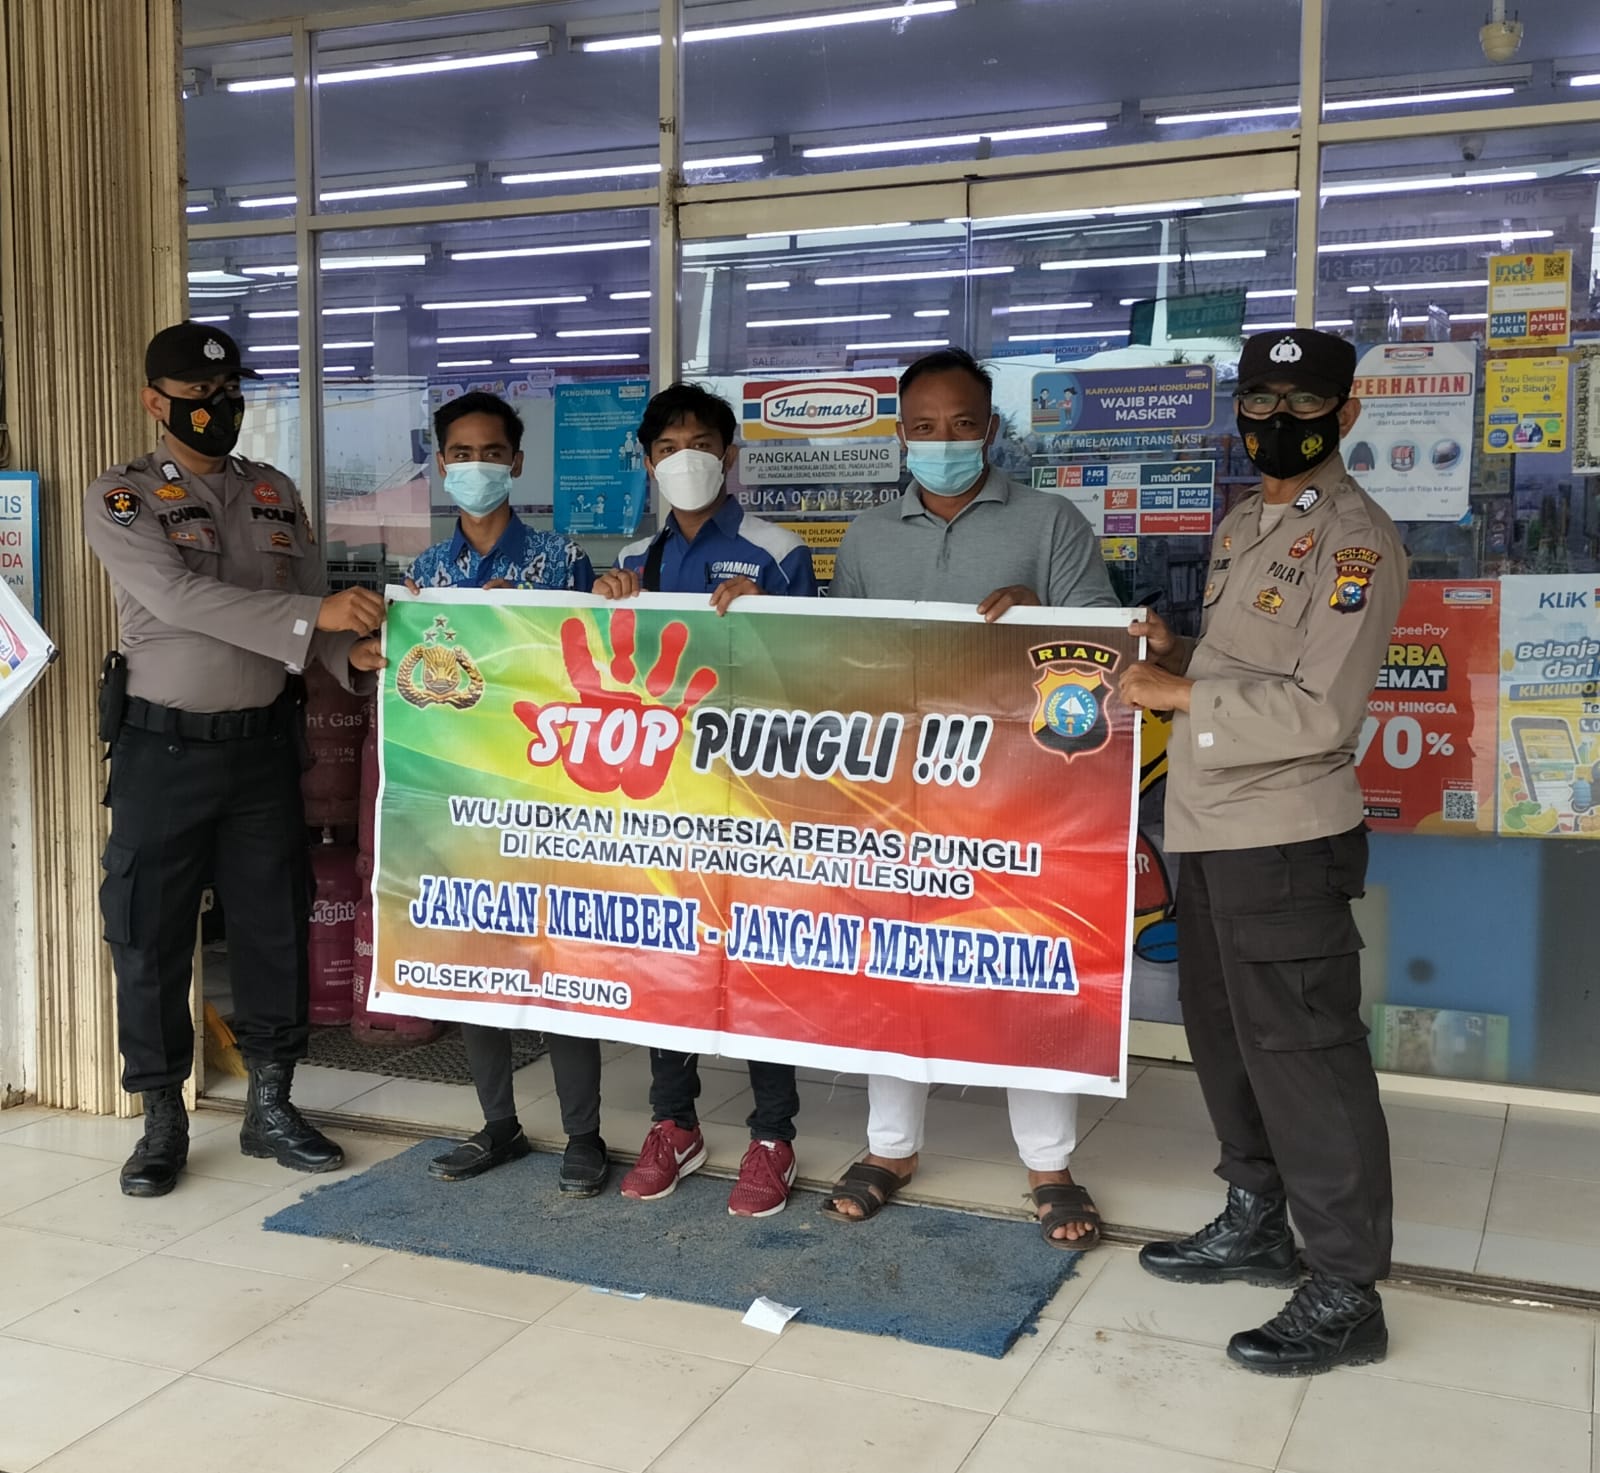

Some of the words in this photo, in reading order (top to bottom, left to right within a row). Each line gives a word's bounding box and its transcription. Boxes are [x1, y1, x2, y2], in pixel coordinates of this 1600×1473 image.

[1495, 273, 1534, 282] PAKET
[1492, 314, 1527, 325] KIRIM
[1530, 313, 1565, 322] AMBIL
[1491, 325, 1527, 334] PAKET
[1530, 322, 1565, 332] PAKET
[1085, 386, 1137, 396] KARYAWAN
[1137, 384, 1158, 394] DAN
[1159, 382, 1209, 392] KONSUMEN
[1352, 375, 1466, 396] PERHATIAN
[1501, 385, 1520, 393] Tapi
[1522, 384, 1557, 393] Sibuk?
[770, 398, 869, 418] Indomaret
[1100, 396, 1145, 409] WAJIB
[1148, 394, 1193, 406] PAKAI
[1115, 408, 1177, 422] MASKER
[1075, 435, 1132, 449] MELAYANI
[1135, 433, 1203, 446] TRANSAKSI
[749, 451, 830, 465] PANGKALAN
[833, 449, 890, 462] LESUNG
[738, 490, 787, 506] BUKA
[852, 488, 900, 504] 22.00
[1155, 496, 1173, 505] BRI
[1180, 489, 1197, 497] TOP
[1197, 489, 1209, 497] UP
[722, 560, 760, 577] YAMAHA
[1266, 560, 1305, 586] POLRI
[1341, 565, 1369, 574] RIAU
[1037, 646, 1111, 664] RIAU
[1517, 639, 1600, 660] Belanja
[1544, 658, 1595, 678] dari
[1399, 702, 1457, 714] HINGGA
[329, 712, 363, 728] Gas
[530, 705, 680, 767] STOP
[694, 709, 902, 781] PUNGLI
[915, 716, 990, 784] !!!
[451, 797, 613, 834] WUJUDKAN
[622, 811, 784, 851] INDONESIA
[793, 825, 902, 861] BEBAS
[911, 837, 1040, 874] PUNGLI
[503, 832, 528, 854] DI
[535, 835, 682, 869] KECAMATAN
[690, 846, 850, 887] PANGKALAN
[858, 867, 973, 897] LESUNG
[411, 877, 539, 935] JANGAN
[547, 887, 698, 952] MEMBERI
[727, 905, 861, 971] JANGAN
[869, 921, 1078, 992] MENERIMA
[398, 963, 484, 989] POLSEK
[490, 972, 539, 993] PKL.
[545, 976, 628, 1006] LESUNG
